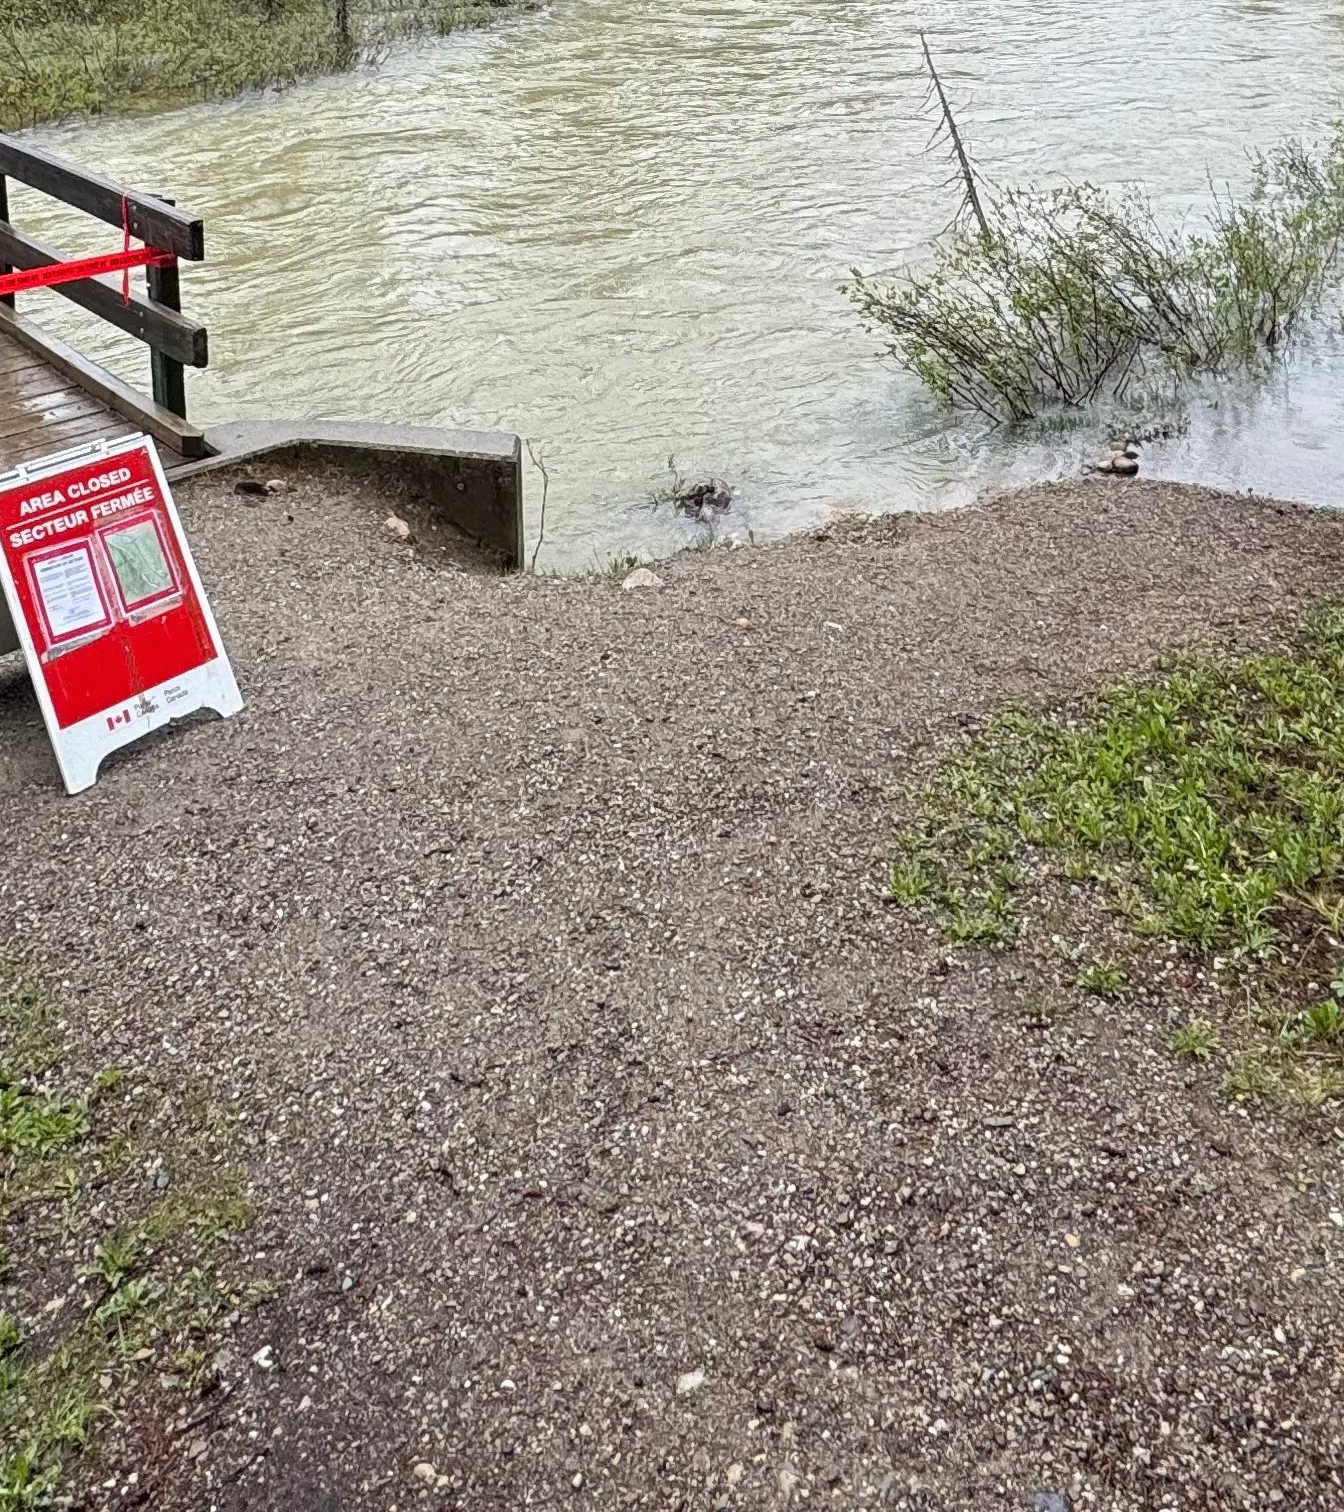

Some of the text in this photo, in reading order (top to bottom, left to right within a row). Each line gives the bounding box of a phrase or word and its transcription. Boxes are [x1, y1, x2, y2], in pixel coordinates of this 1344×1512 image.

[19, 467, 132, 516] AREA CLOSED
[10, 487, 154, 548] SECTEUR FERMÉE
[166, 690, 189, 704] Canada
